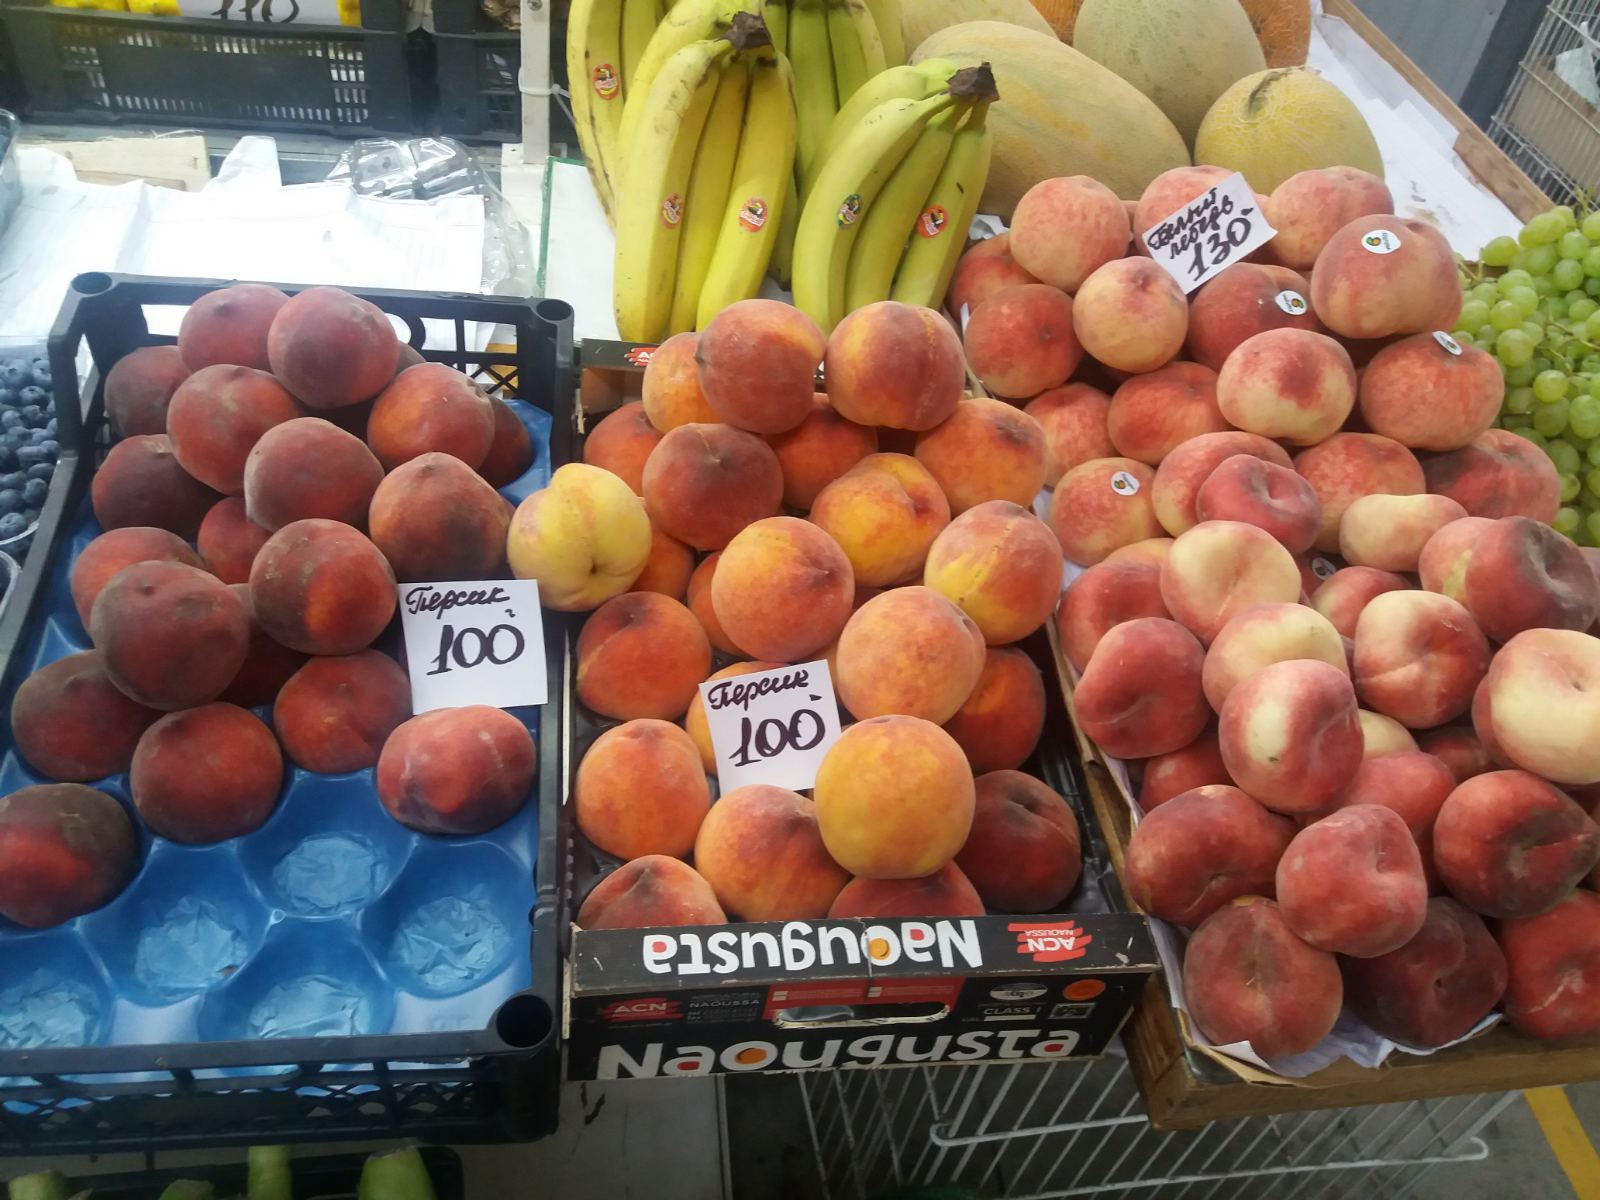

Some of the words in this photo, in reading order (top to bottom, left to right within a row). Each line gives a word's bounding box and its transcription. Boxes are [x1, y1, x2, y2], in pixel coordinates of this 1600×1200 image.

[405, 585, 511, 620] Персик
[707, 669, 810, 711] Персик
[643, 919, 983, 975] Naougusta
[1026, 936, 1076, 952] ACN
[615, 1002, 668, 1013] ACN
[689, 999, 761, 1009] NAOUSSA
[984, 1006, 1031, 1015] CLASS
[597, 1029, 1081, 1080] Naougusta
